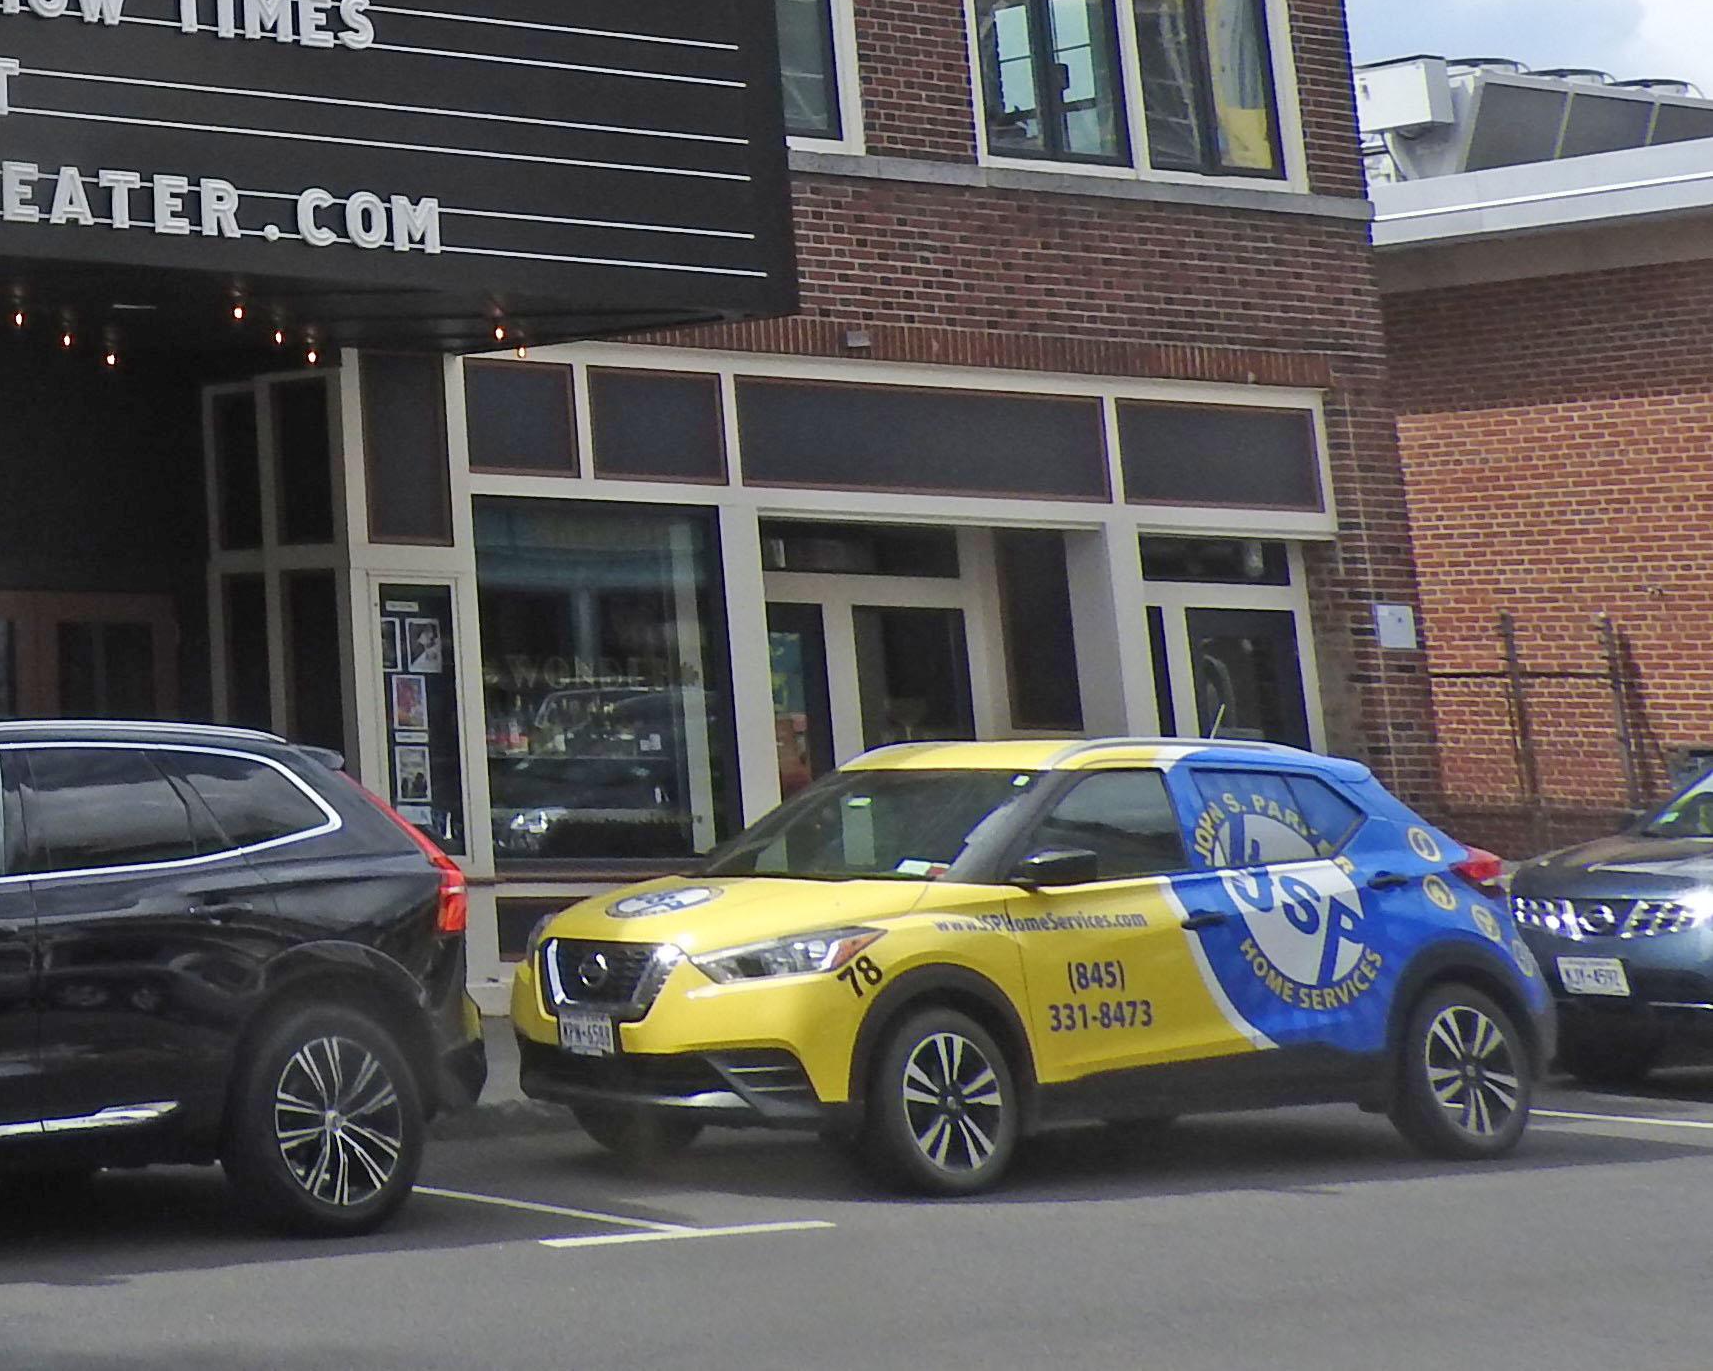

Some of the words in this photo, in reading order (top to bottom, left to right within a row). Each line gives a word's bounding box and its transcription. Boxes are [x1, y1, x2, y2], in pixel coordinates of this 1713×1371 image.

[836, 954, 885, 999] 78
[1067, 960, 1126, 994] (845)
[1239, 939, 1294, 1003] HOME
[1298, 947, 1383, 1011] SERVICES
[1048, 1000, 1153, 1032] 331-8473
